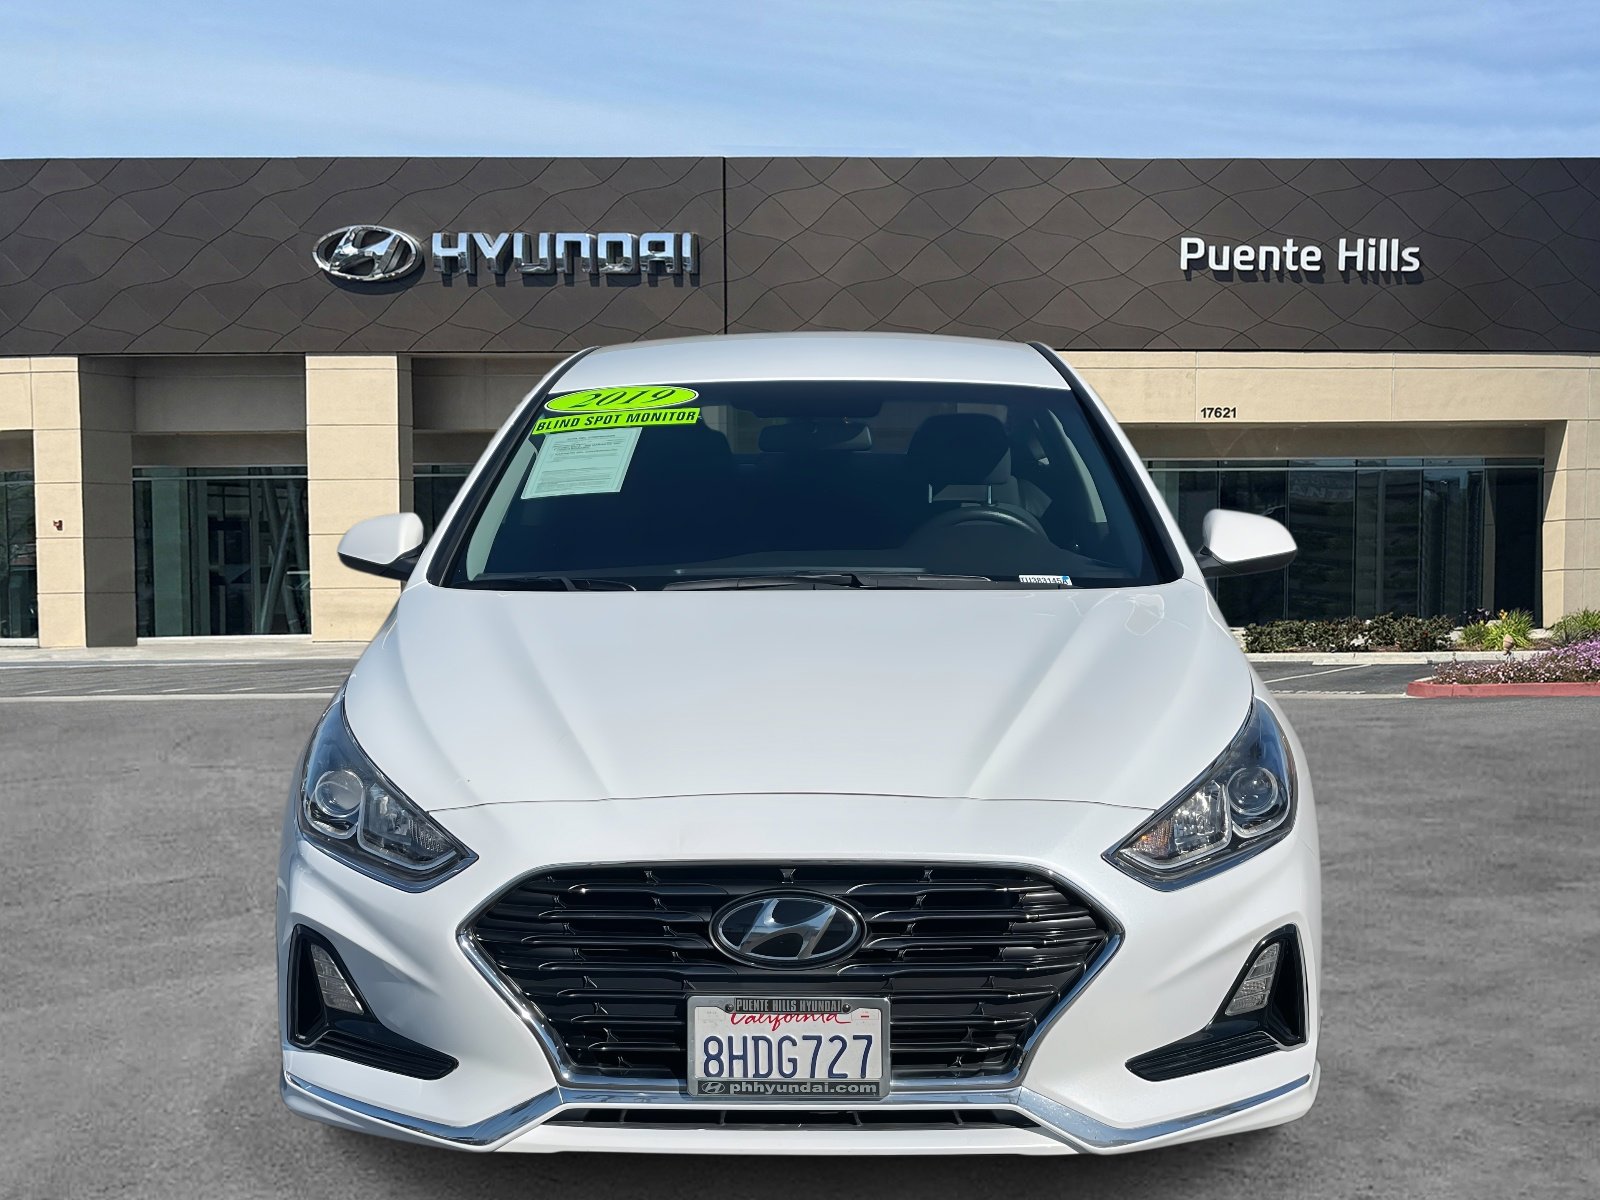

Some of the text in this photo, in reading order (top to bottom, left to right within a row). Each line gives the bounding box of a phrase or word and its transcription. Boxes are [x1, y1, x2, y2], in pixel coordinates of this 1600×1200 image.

[431, 231, 699, 274] HYUNDAI
[1179, 237, 1421, 272] Puente Hills
[567, 389, 676, 409] 2019
[536, 410, 696, 432] BLIND SPOT MONITOR
[1200, 407, 1237, 419] 17621
[736, 1000, 841, 1012] PUENTE HILLS HYUNDAI
[730, 1012, 852, 1032] California
[703, 1035, 873, 1078] 8HDG727
[729, 1081, 877, 1095] phhyundai.com
